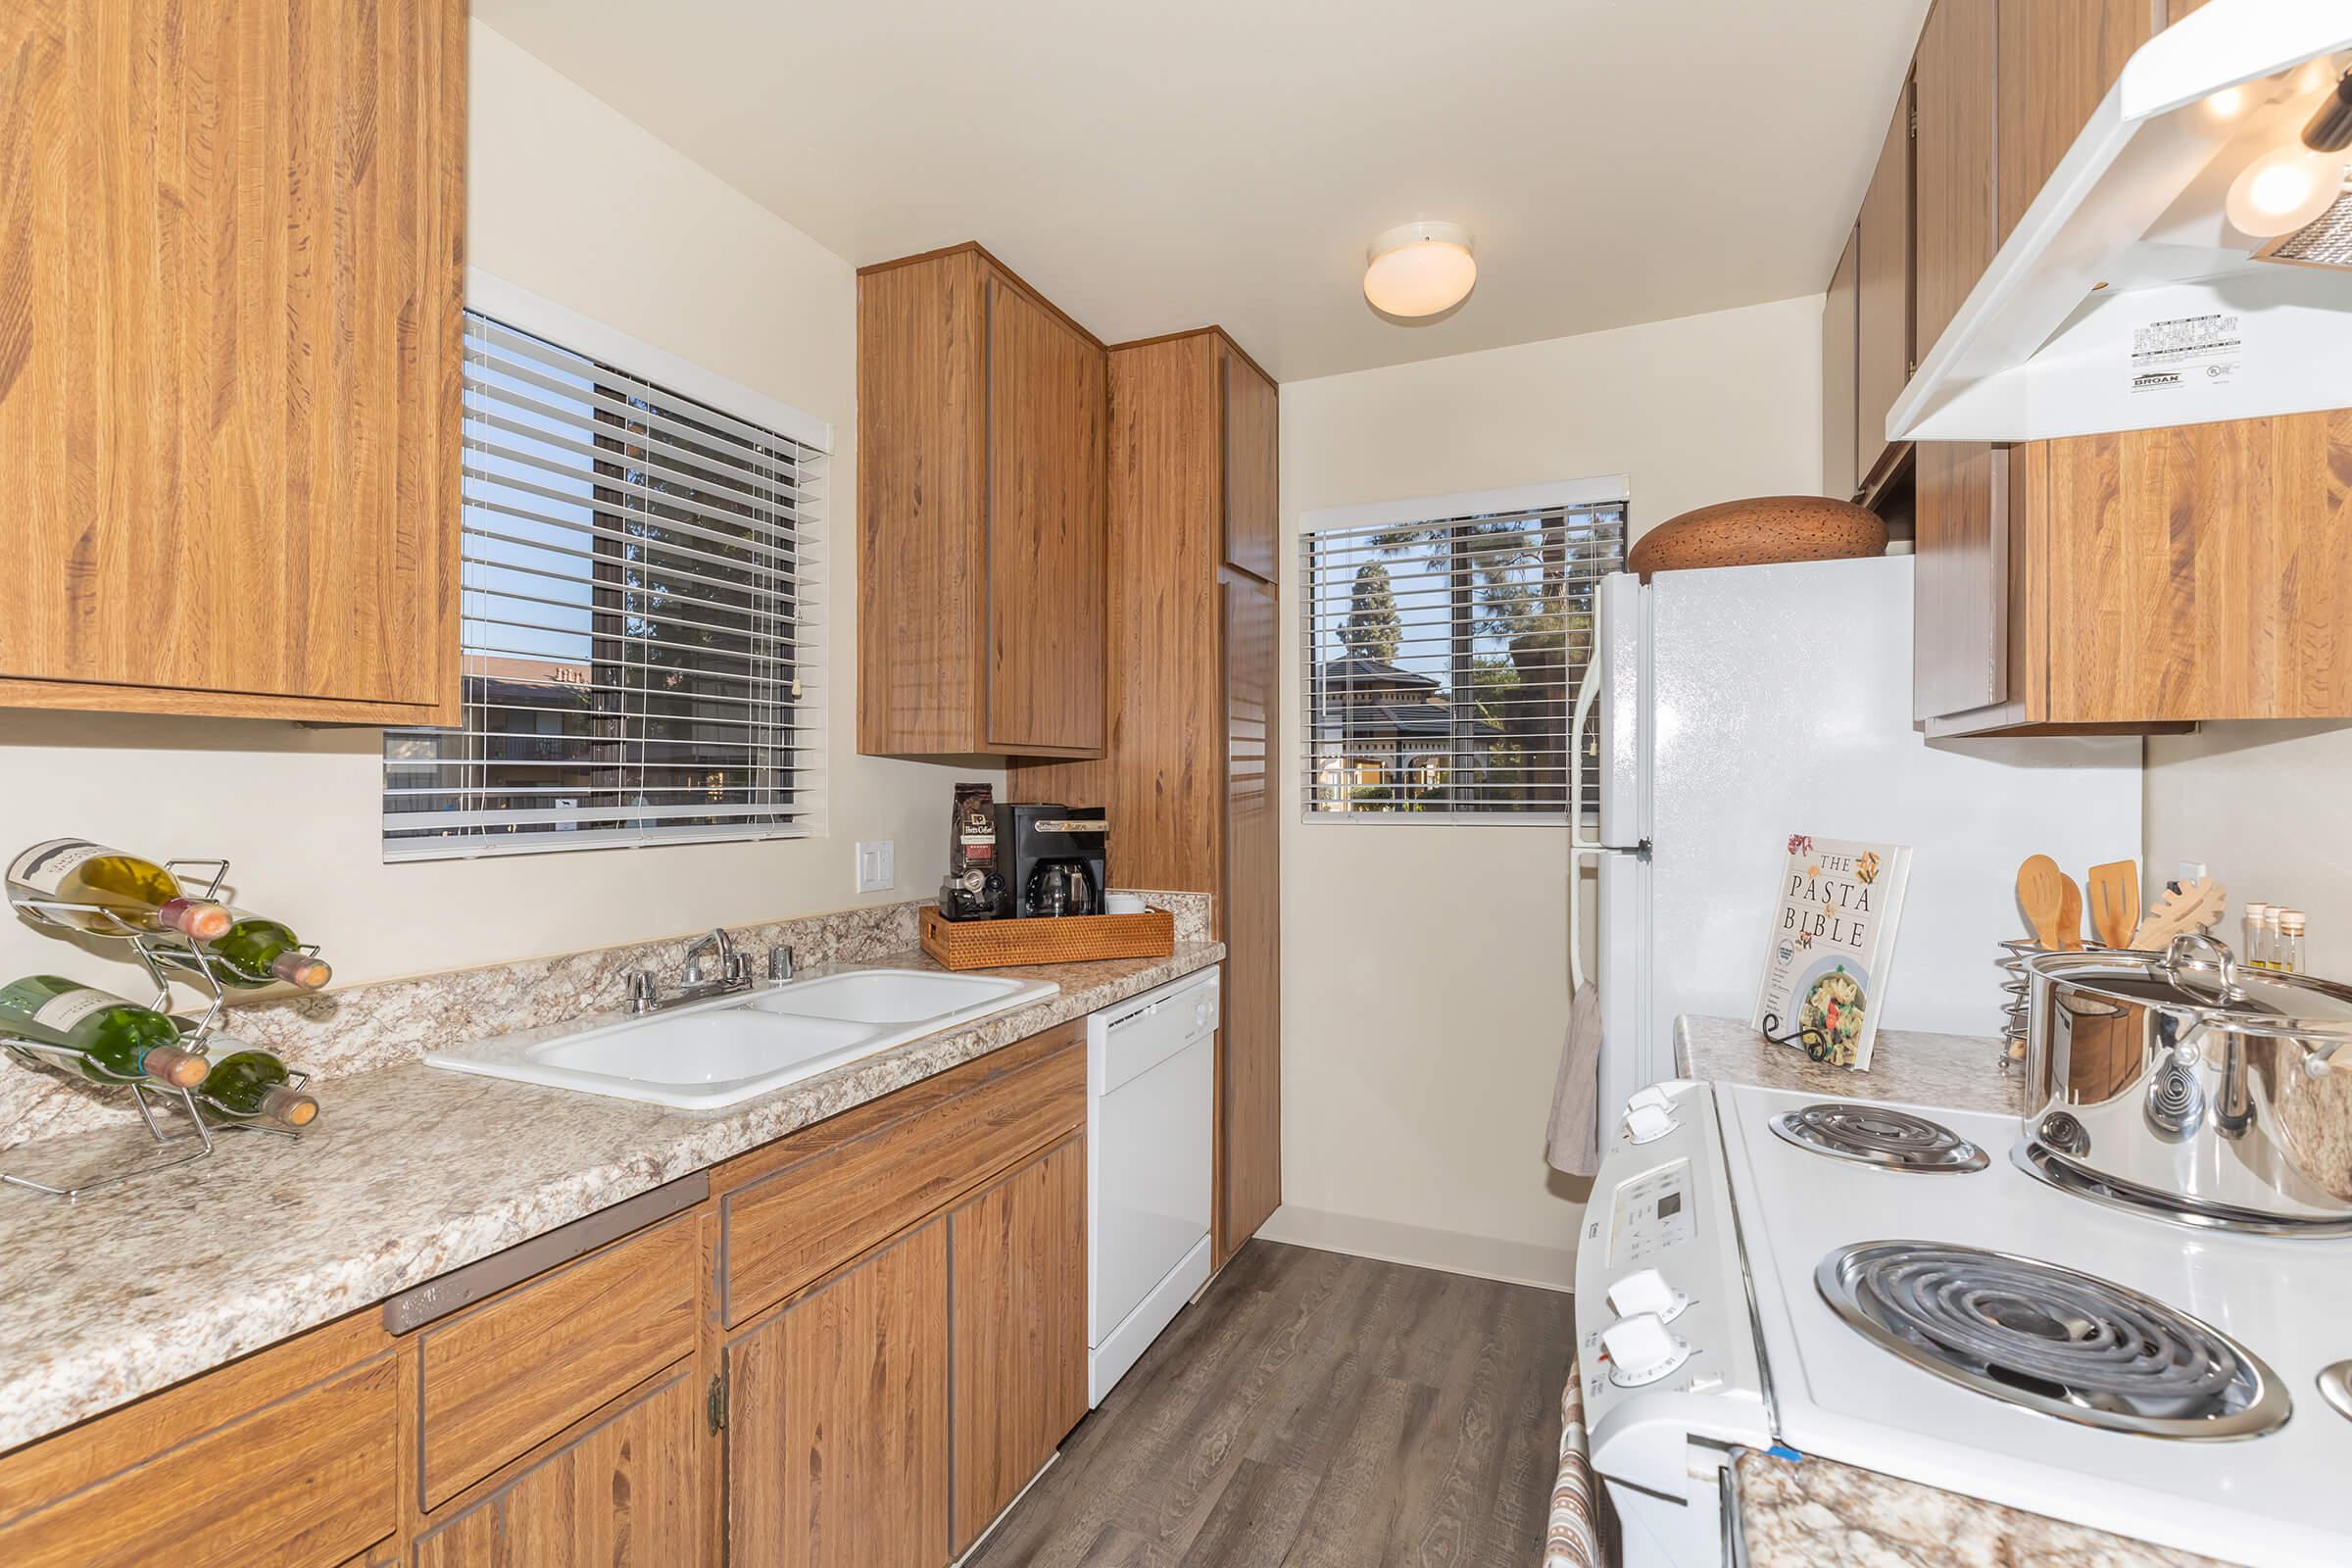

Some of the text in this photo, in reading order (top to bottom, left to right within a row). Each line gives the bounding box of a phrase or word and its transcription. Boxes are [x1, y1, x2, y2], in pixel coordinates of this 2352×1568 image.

[2133, 375, 2179, 386] BROAN
[1820, 855, 1851, 872] THE
[1789, 875, 1871, 912] PASTA
[1784, 907, 1865, 948] BIBLE
